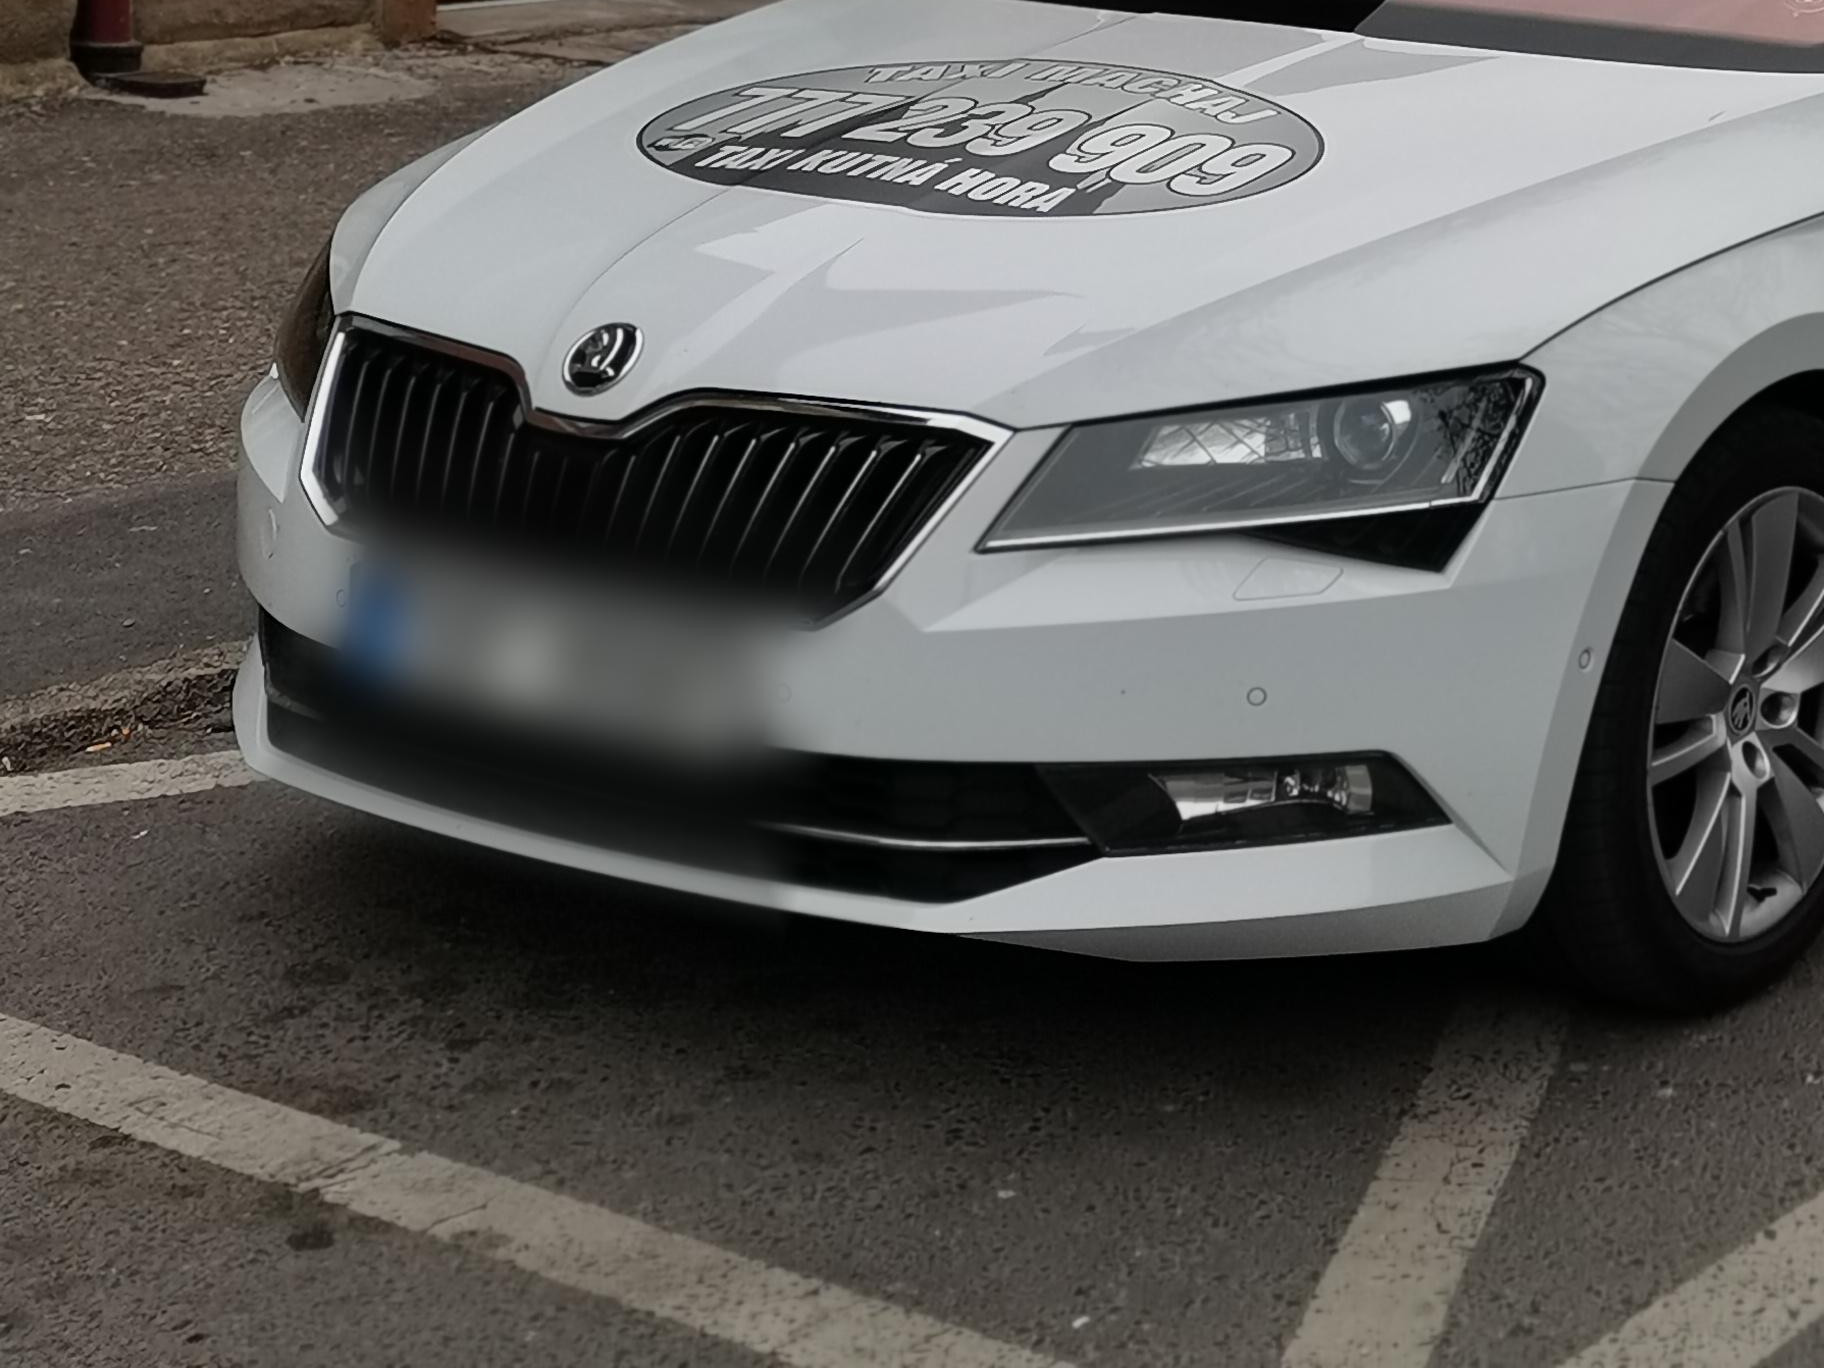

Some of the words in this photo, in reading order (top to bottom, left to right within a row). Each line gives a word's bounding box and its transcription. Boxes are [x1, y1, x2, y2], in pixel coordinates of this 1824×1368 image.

[866, 62, 1030, 83] TAXI
[1024, 64, 1281, 125] MACHAJ
[669, 86, 911, 139] 777
[840, 96, 1092, 157] 239
[1048, 122, 1296, 198] 909
[694, 144, 806, 171] TAXI
[786, 149, 963, 186] KUTNÁ
[933, 167, 1077, 213] HORA
